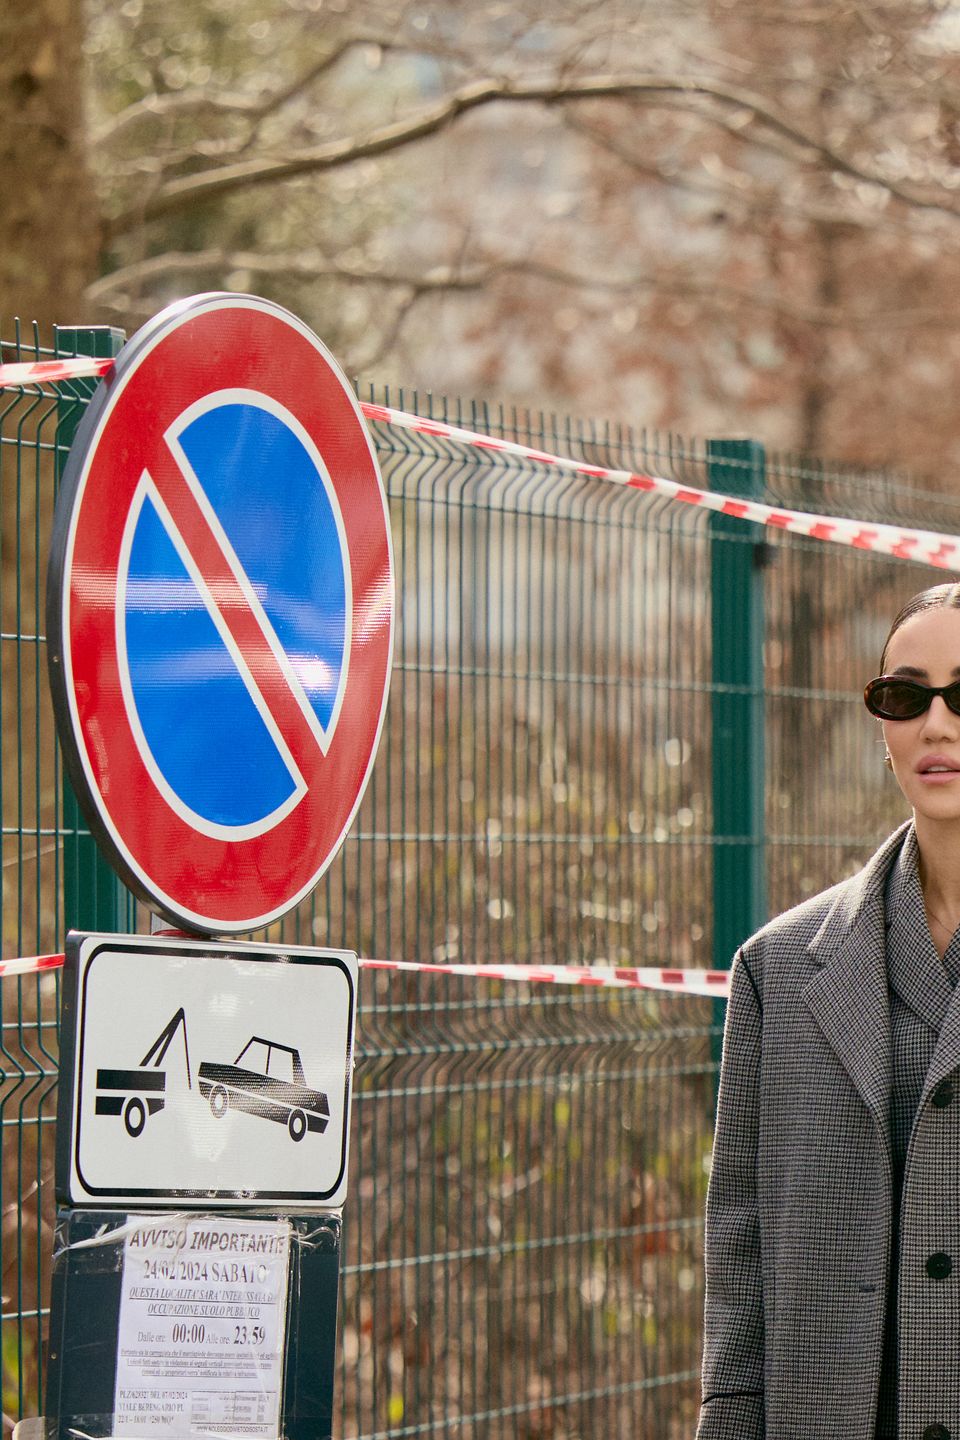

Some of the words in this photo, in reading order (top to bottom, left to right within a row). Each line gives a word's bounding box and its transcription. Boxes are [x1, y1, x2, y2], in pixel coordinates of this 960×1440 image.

[130, 1229, 187, 1249] AVVISO
[190, 1231, 286, 1254] IMPORTANTE
[144, 1259, 208, 1281] 24/02/2024
[130, 1287, 159, 1299] QUESTA
[148, 1303, 199, 1315] OCCUPAZIONE
[200, 1305, 225, 1316] SUOLO
[226, 1306, 260, 1318] PUBBICO
[138, 1331, 154, 1342] Dalle
[172, 1323, 205, 1343] 00:00
